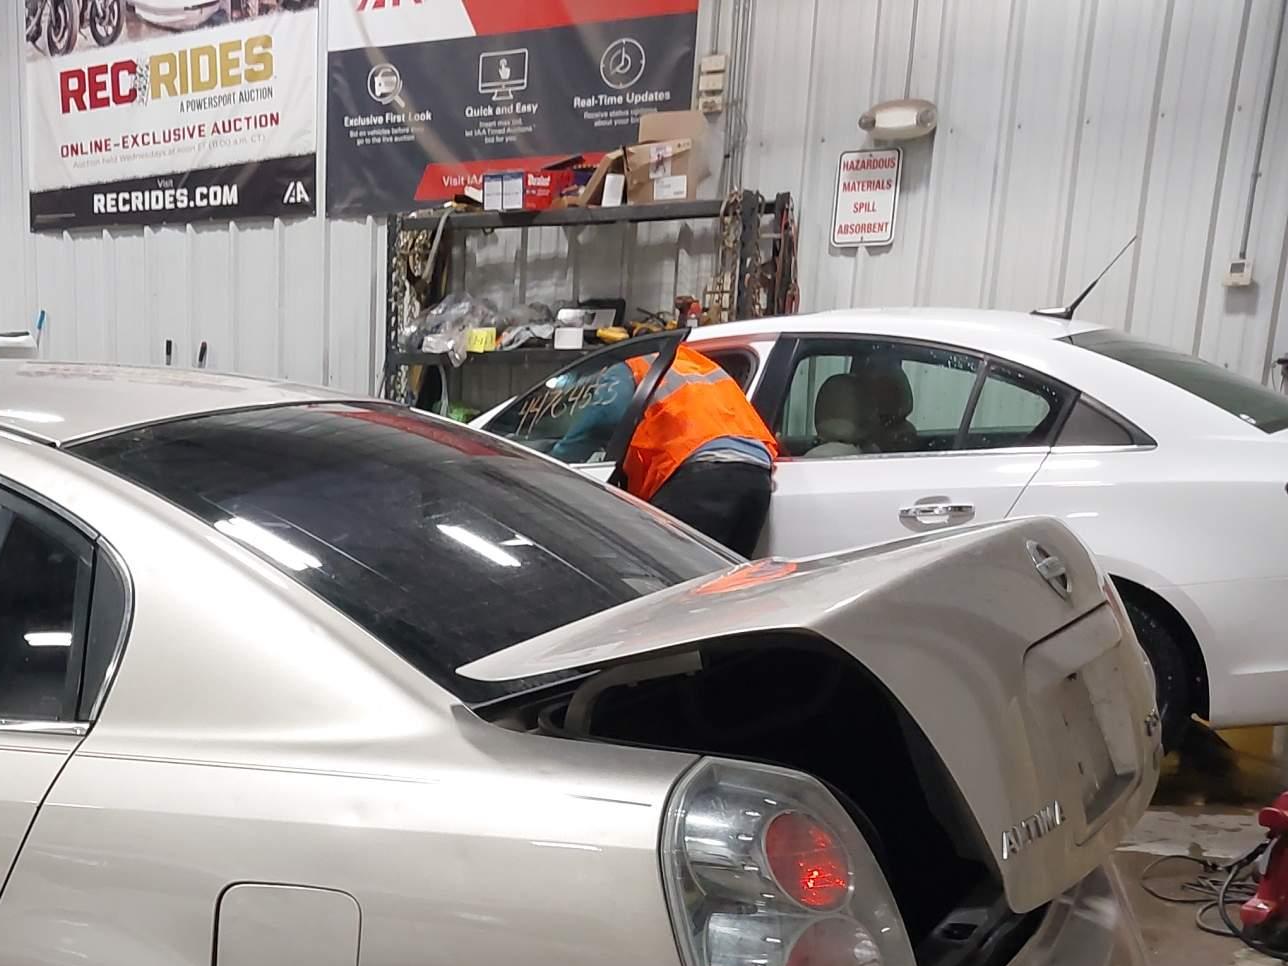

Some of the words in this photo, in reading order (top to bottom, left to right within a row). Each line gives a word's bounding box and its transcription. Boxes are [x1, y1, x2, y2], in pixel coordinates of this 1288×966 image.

[149, 34, 274, 101] RIDES
[179, 102, 186, 113] A
[186, 93, 237, 113] POWERSPORT
[238, 87, 273, 105] AUCTION
[573, 95, 623, 109] Real-Time
[626, 90, 671, 105] Updates
[465, 104, 493, 118] Quick
[495, 104, 514, 115] and
[516, 103, 539, 116] Easy
[344, 113, 384, 127] Exclusive
[385, 112, 405, 124] First
[408, 110, 432, 122] Look
[61, 124, 206, 158] ONLINE-EXCLUSIVE
[211, 112, 280, 136] AUCTION
[843, 158, 895, 170] HAZARDOUS
[157, 178, 174, 189] Visit
[443, 175, 464, 187] Visit
[843, 179, 892, 192] MATERIALS
[93, 184, 238, 214] RECRIDES.COM
[853, 200, 876, 213] SPILL
[837, 222, 889, 235] ABSORBENT
